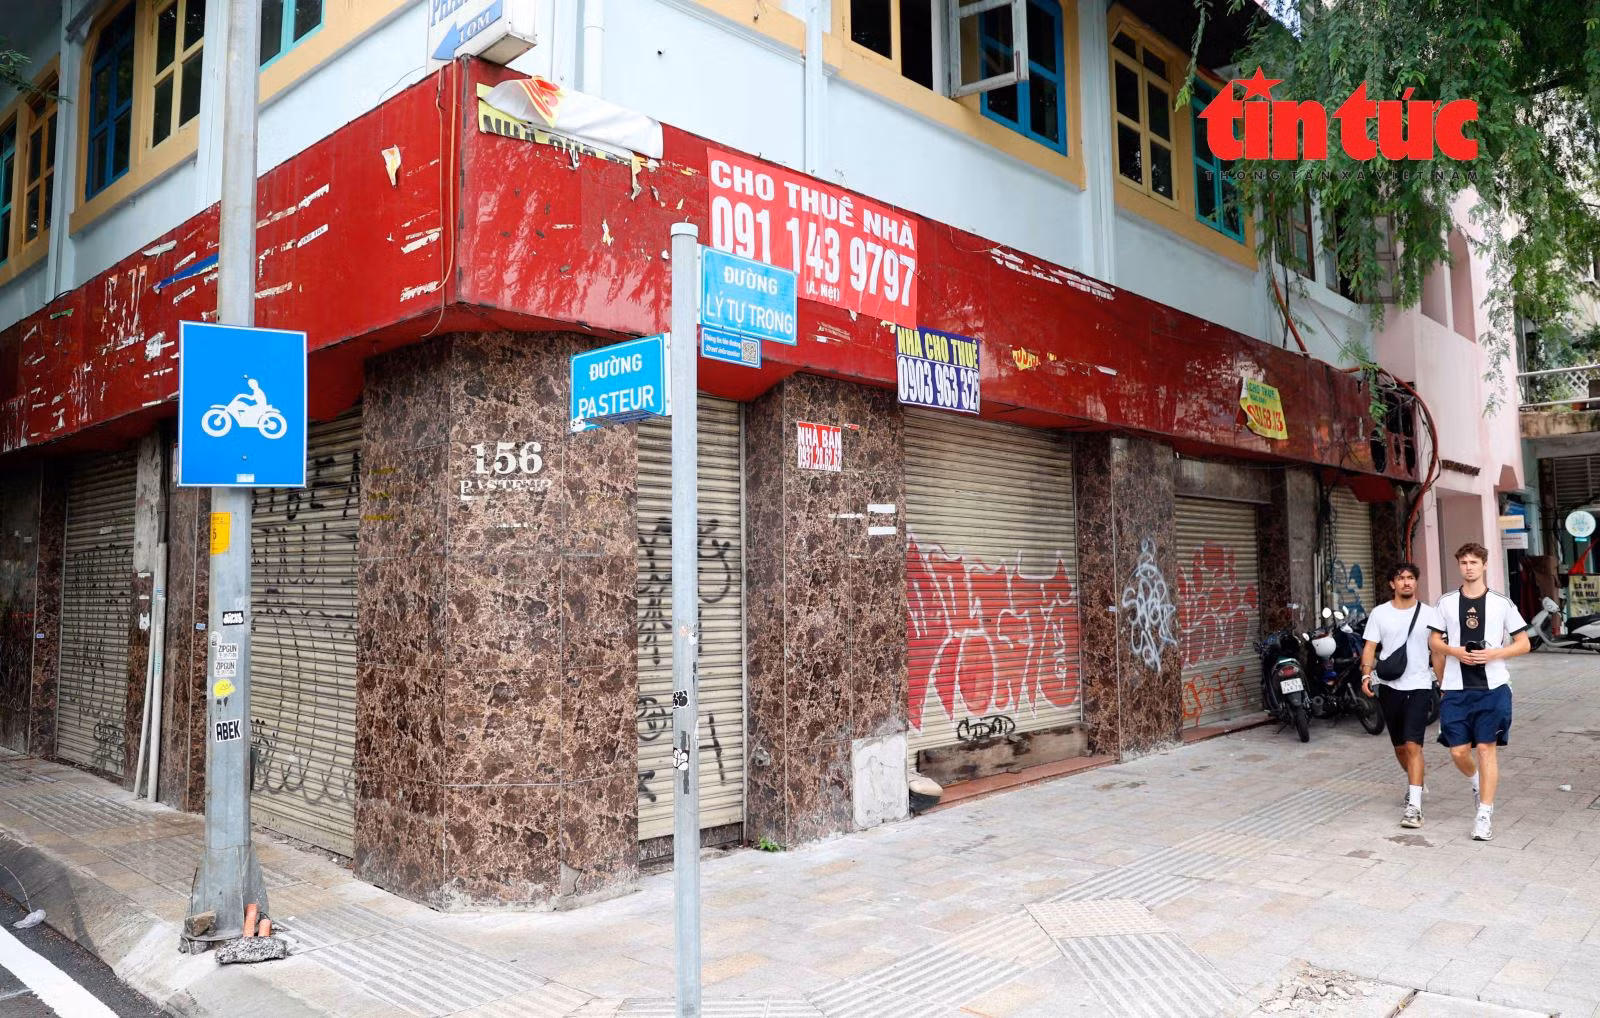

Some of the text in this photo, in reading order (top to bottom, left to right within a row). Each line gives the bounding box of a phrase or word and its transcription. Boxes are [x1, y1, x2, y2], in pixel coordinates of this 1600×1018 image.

[710, 159, 916, 251] CHO THUÊ NHÀ
[711, 195, 916, 307] 091 143 9797
[723, 266, 778, 295] ĐƯỜNG
[706, 291, 793, 335] LÝ TỰ TRỌNG
[588, 353, 643, 382] ĐƯỜNG
[924, 332, 950, 364] CHO
[950, 338, 979, 369] THUÊ
[898, 356, 934, 404] 0903
[934, 363, 959, 408] 963
[578, 384, 655, 419] PASTEUR
[470, 441, 543, 475] 156
[215, 661, 235, 670] ZIPGUN
[218, 644, 237, 653] ZIPGUN
[215, 720, 241, 742] ABEK
